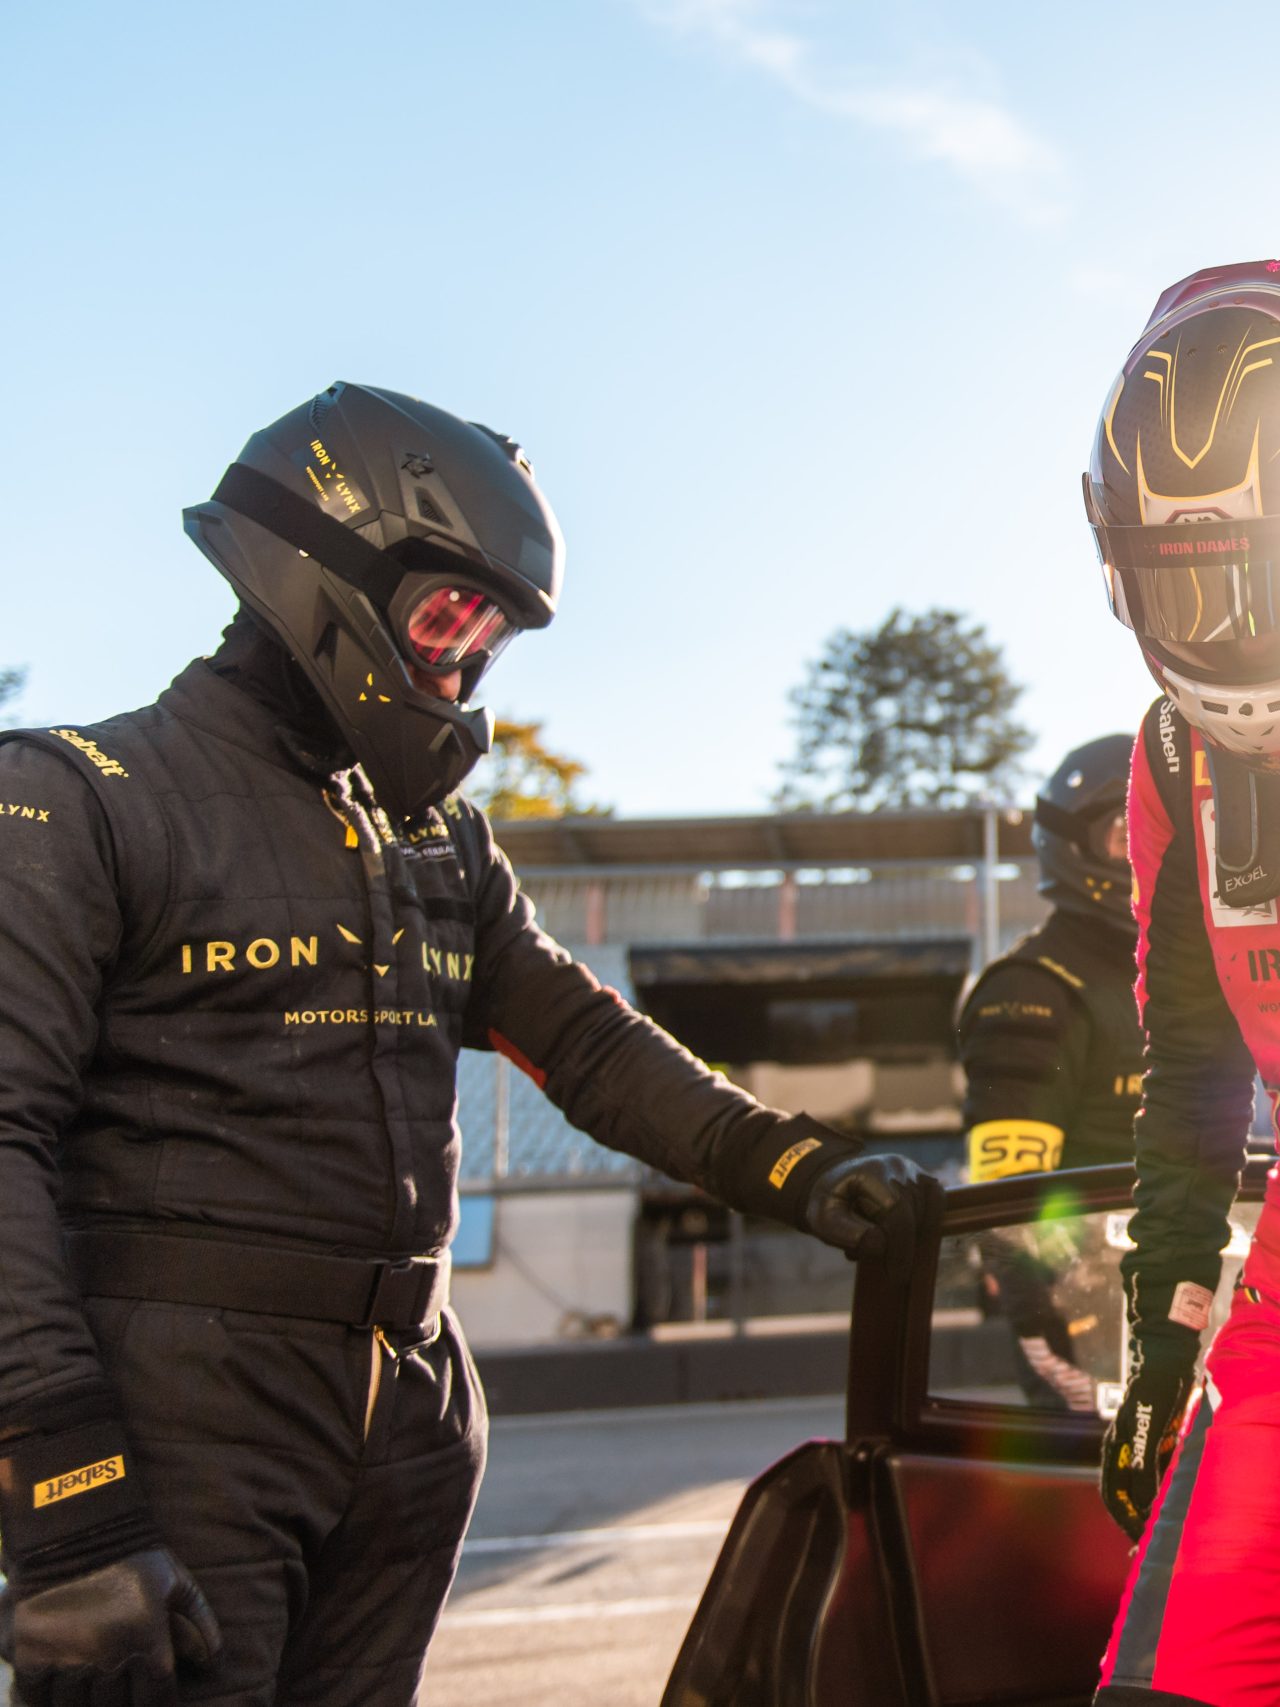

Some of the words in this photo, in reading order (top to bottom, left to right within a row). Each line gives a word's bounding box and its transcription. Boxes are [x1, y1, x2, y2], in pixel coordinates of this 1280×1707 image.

[310, 439, 331, 466] IRON
[335, 482, 361, 513] LYNX
[1159, 542, 1194, 556] IRON
[1197, 536, 1250, 554] DAMES
[48, 729, 125, 776] Sabelt
[0, 803, 50, 823] LYNX
[182, 936, 318, 974] IRON
[421, 941, 475, 982] LYNX
[418, 1012, 438, 1027] LA
[43, 1459, 118, 1501] Sabelt
